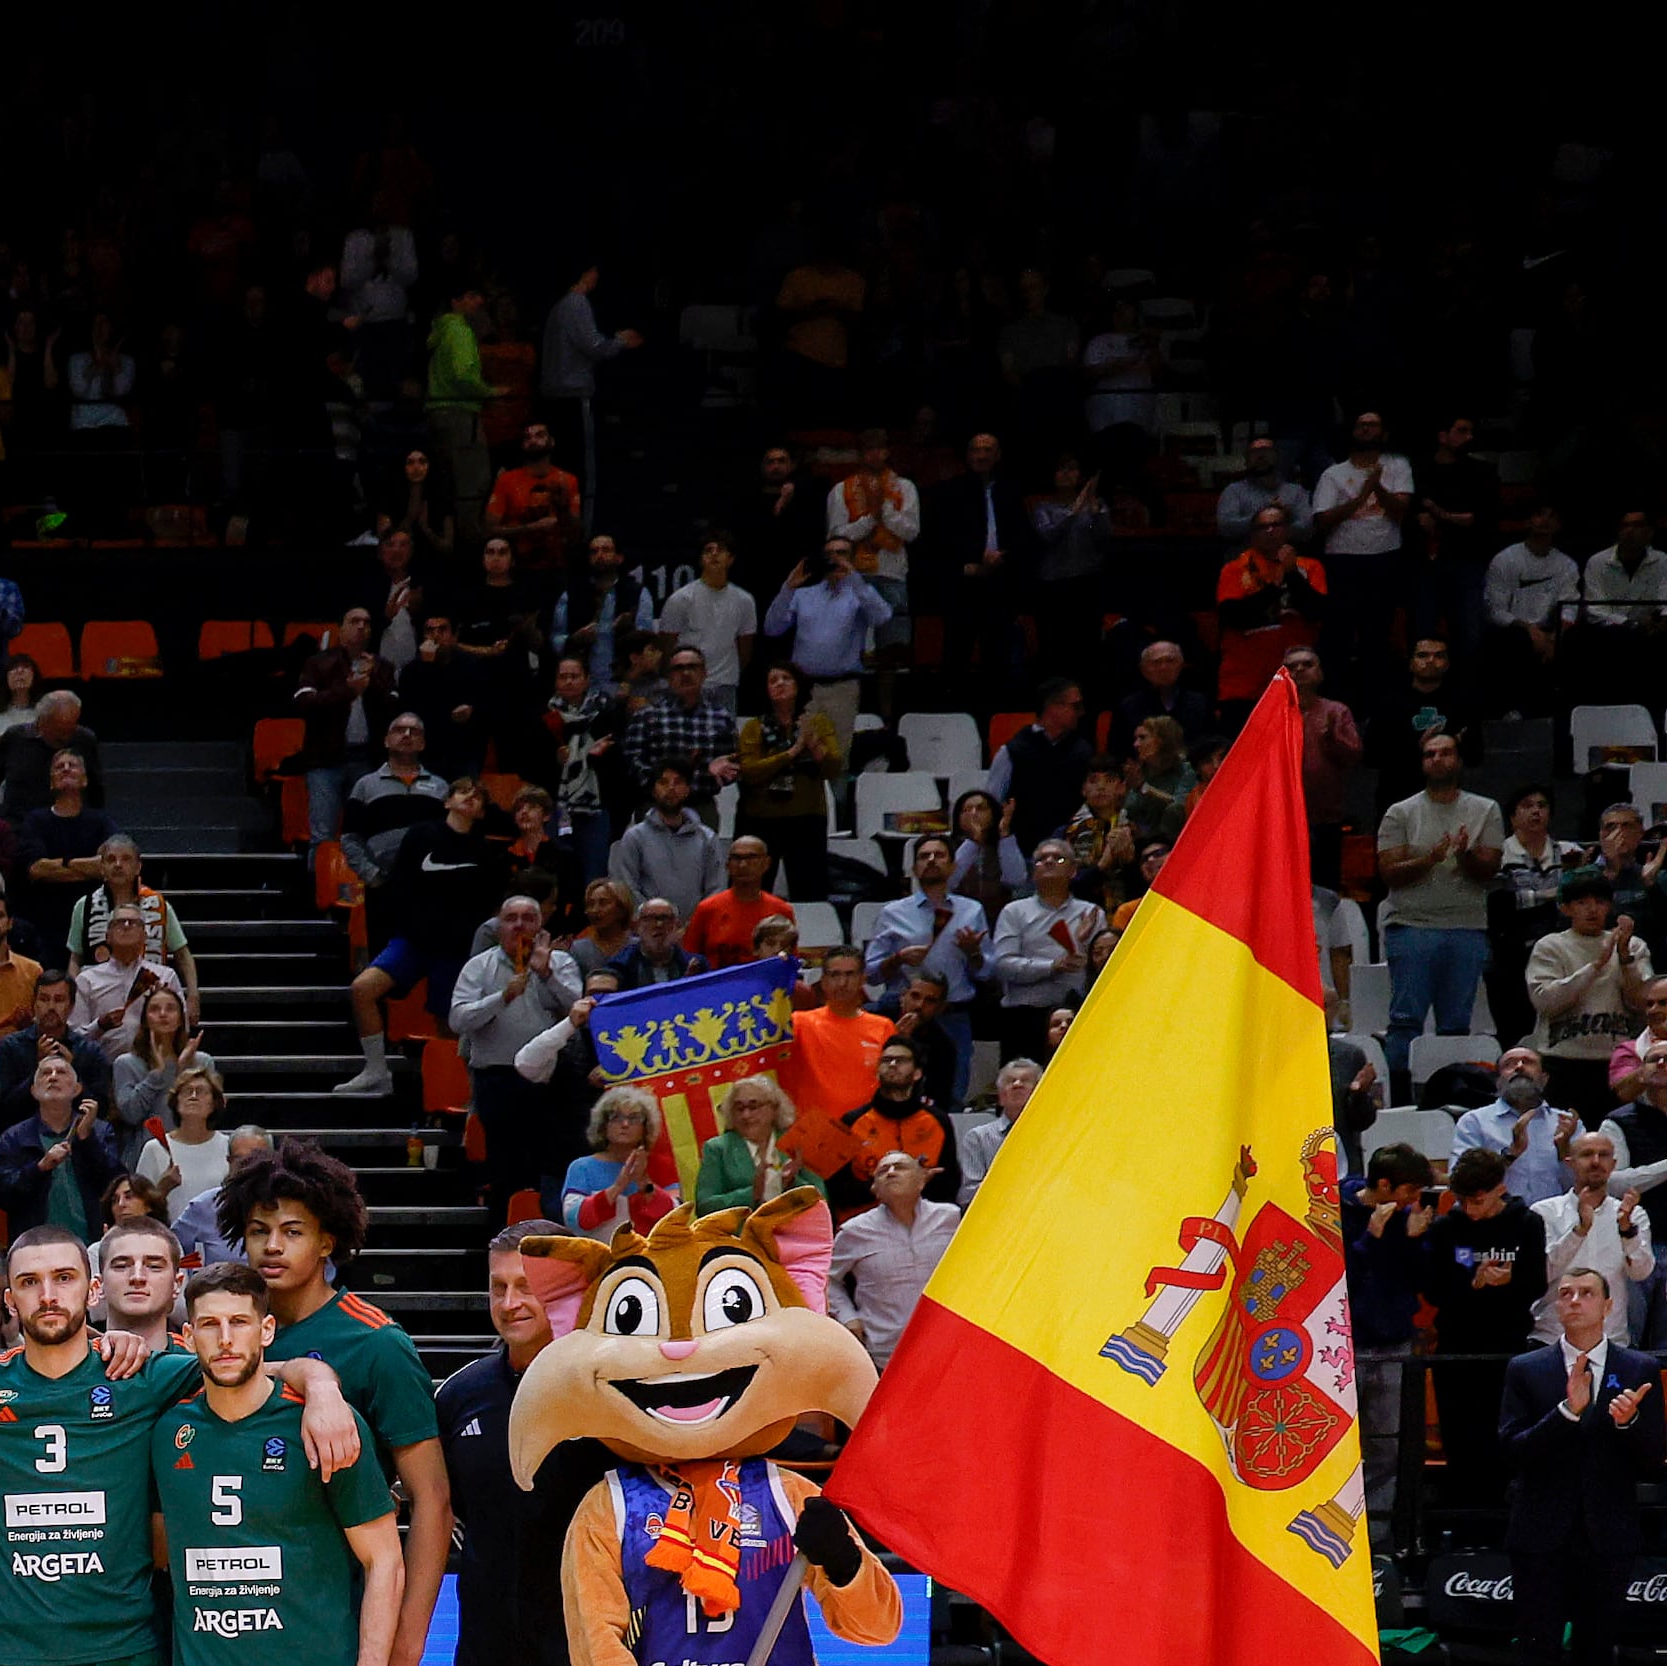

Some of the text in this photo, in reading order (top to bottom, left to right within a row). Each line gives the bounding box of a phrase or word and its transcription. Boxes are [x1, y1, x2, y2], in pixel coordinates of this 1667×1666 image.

[34, 1425, 67, 1472] 3
[16, 1503, 94, 1516] PETROL
[211, 1476, 242, 1526] 5
[8, 1531, 46, 1543] Energija
[48, 1532, 61, 1540] za
[13, 1552, 104, 1582] ARGETA
[196, 1558, 270, 1571] PETROL
[224, 1586, 237, 1595] za
[193, 1607, 284, 1638] ARGETA
